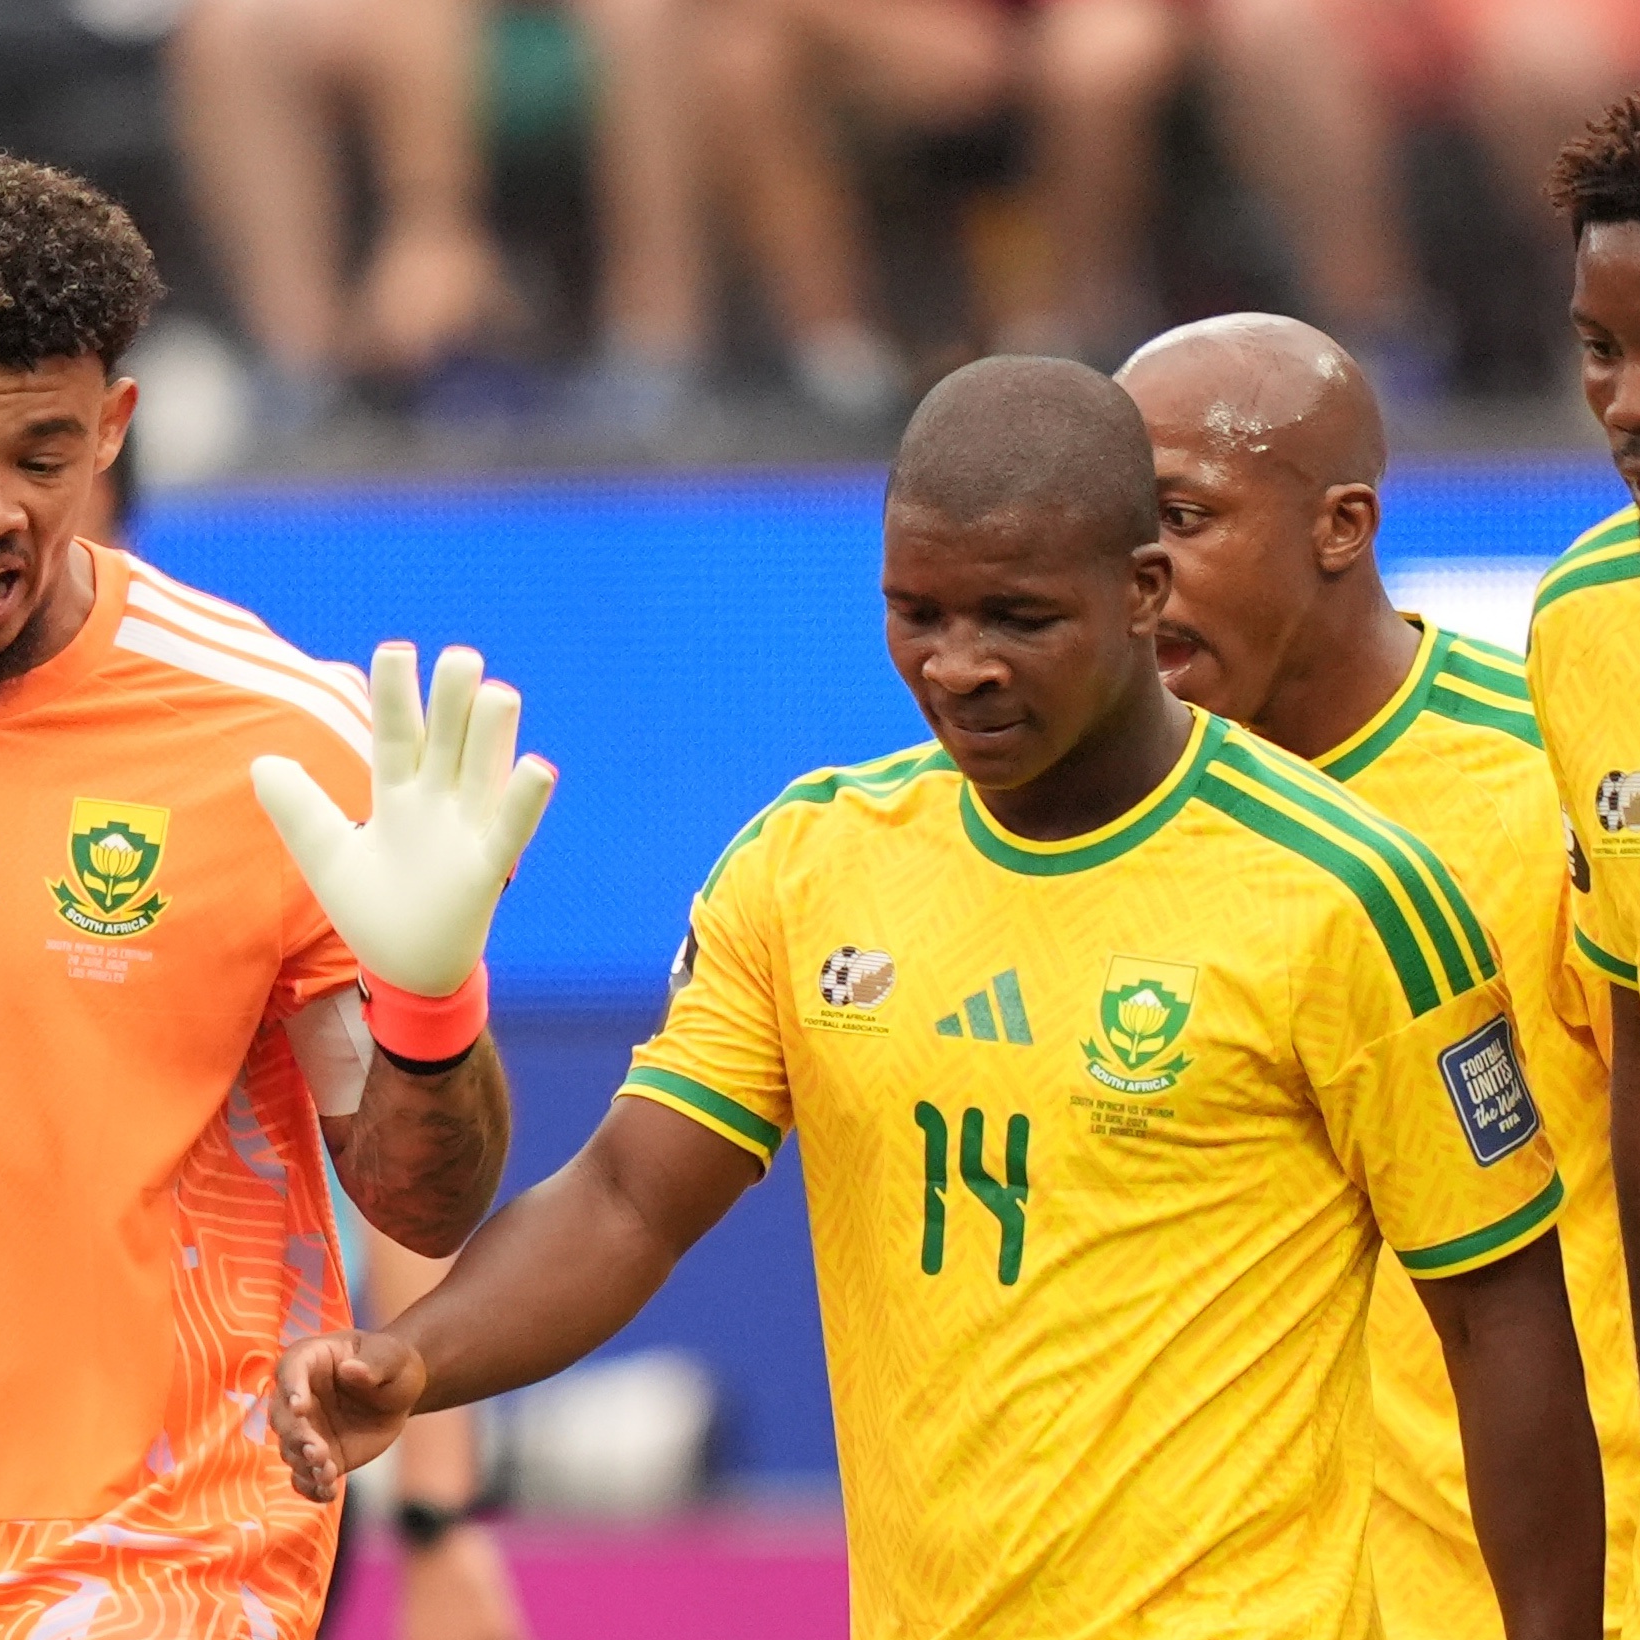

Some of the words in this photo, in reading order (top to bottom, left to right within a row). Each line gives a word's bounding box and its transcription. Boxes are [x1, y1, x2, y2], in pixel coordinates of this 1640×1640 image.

[65, 907, 104, 933] SOUTH
[104, 916, 149, 934] AFRICA
[804, 1018, 839, 1028] FOOTBALL
[842, 1023, 889, 1033] ASSOCIATION
[820, 1010, 844, 1019] SOUTH
[846, 1013, 876, 1022] AFRICAN
[1459, 1038, 1505, 1081] FOOTBALL
[1090, 1064, 1125, 1090] SOUTH
[1126, 1077, 1170, 1092] AFRICA
[1466, 1055, 1513, 1105] UNITES
[1473, 1103, 1498, 1129] the
[1495, 1079, 1523, 1116] World
[1498, 1112, 1521, 1133] FIFA
[914, 1099, 1031, 1286] 14
